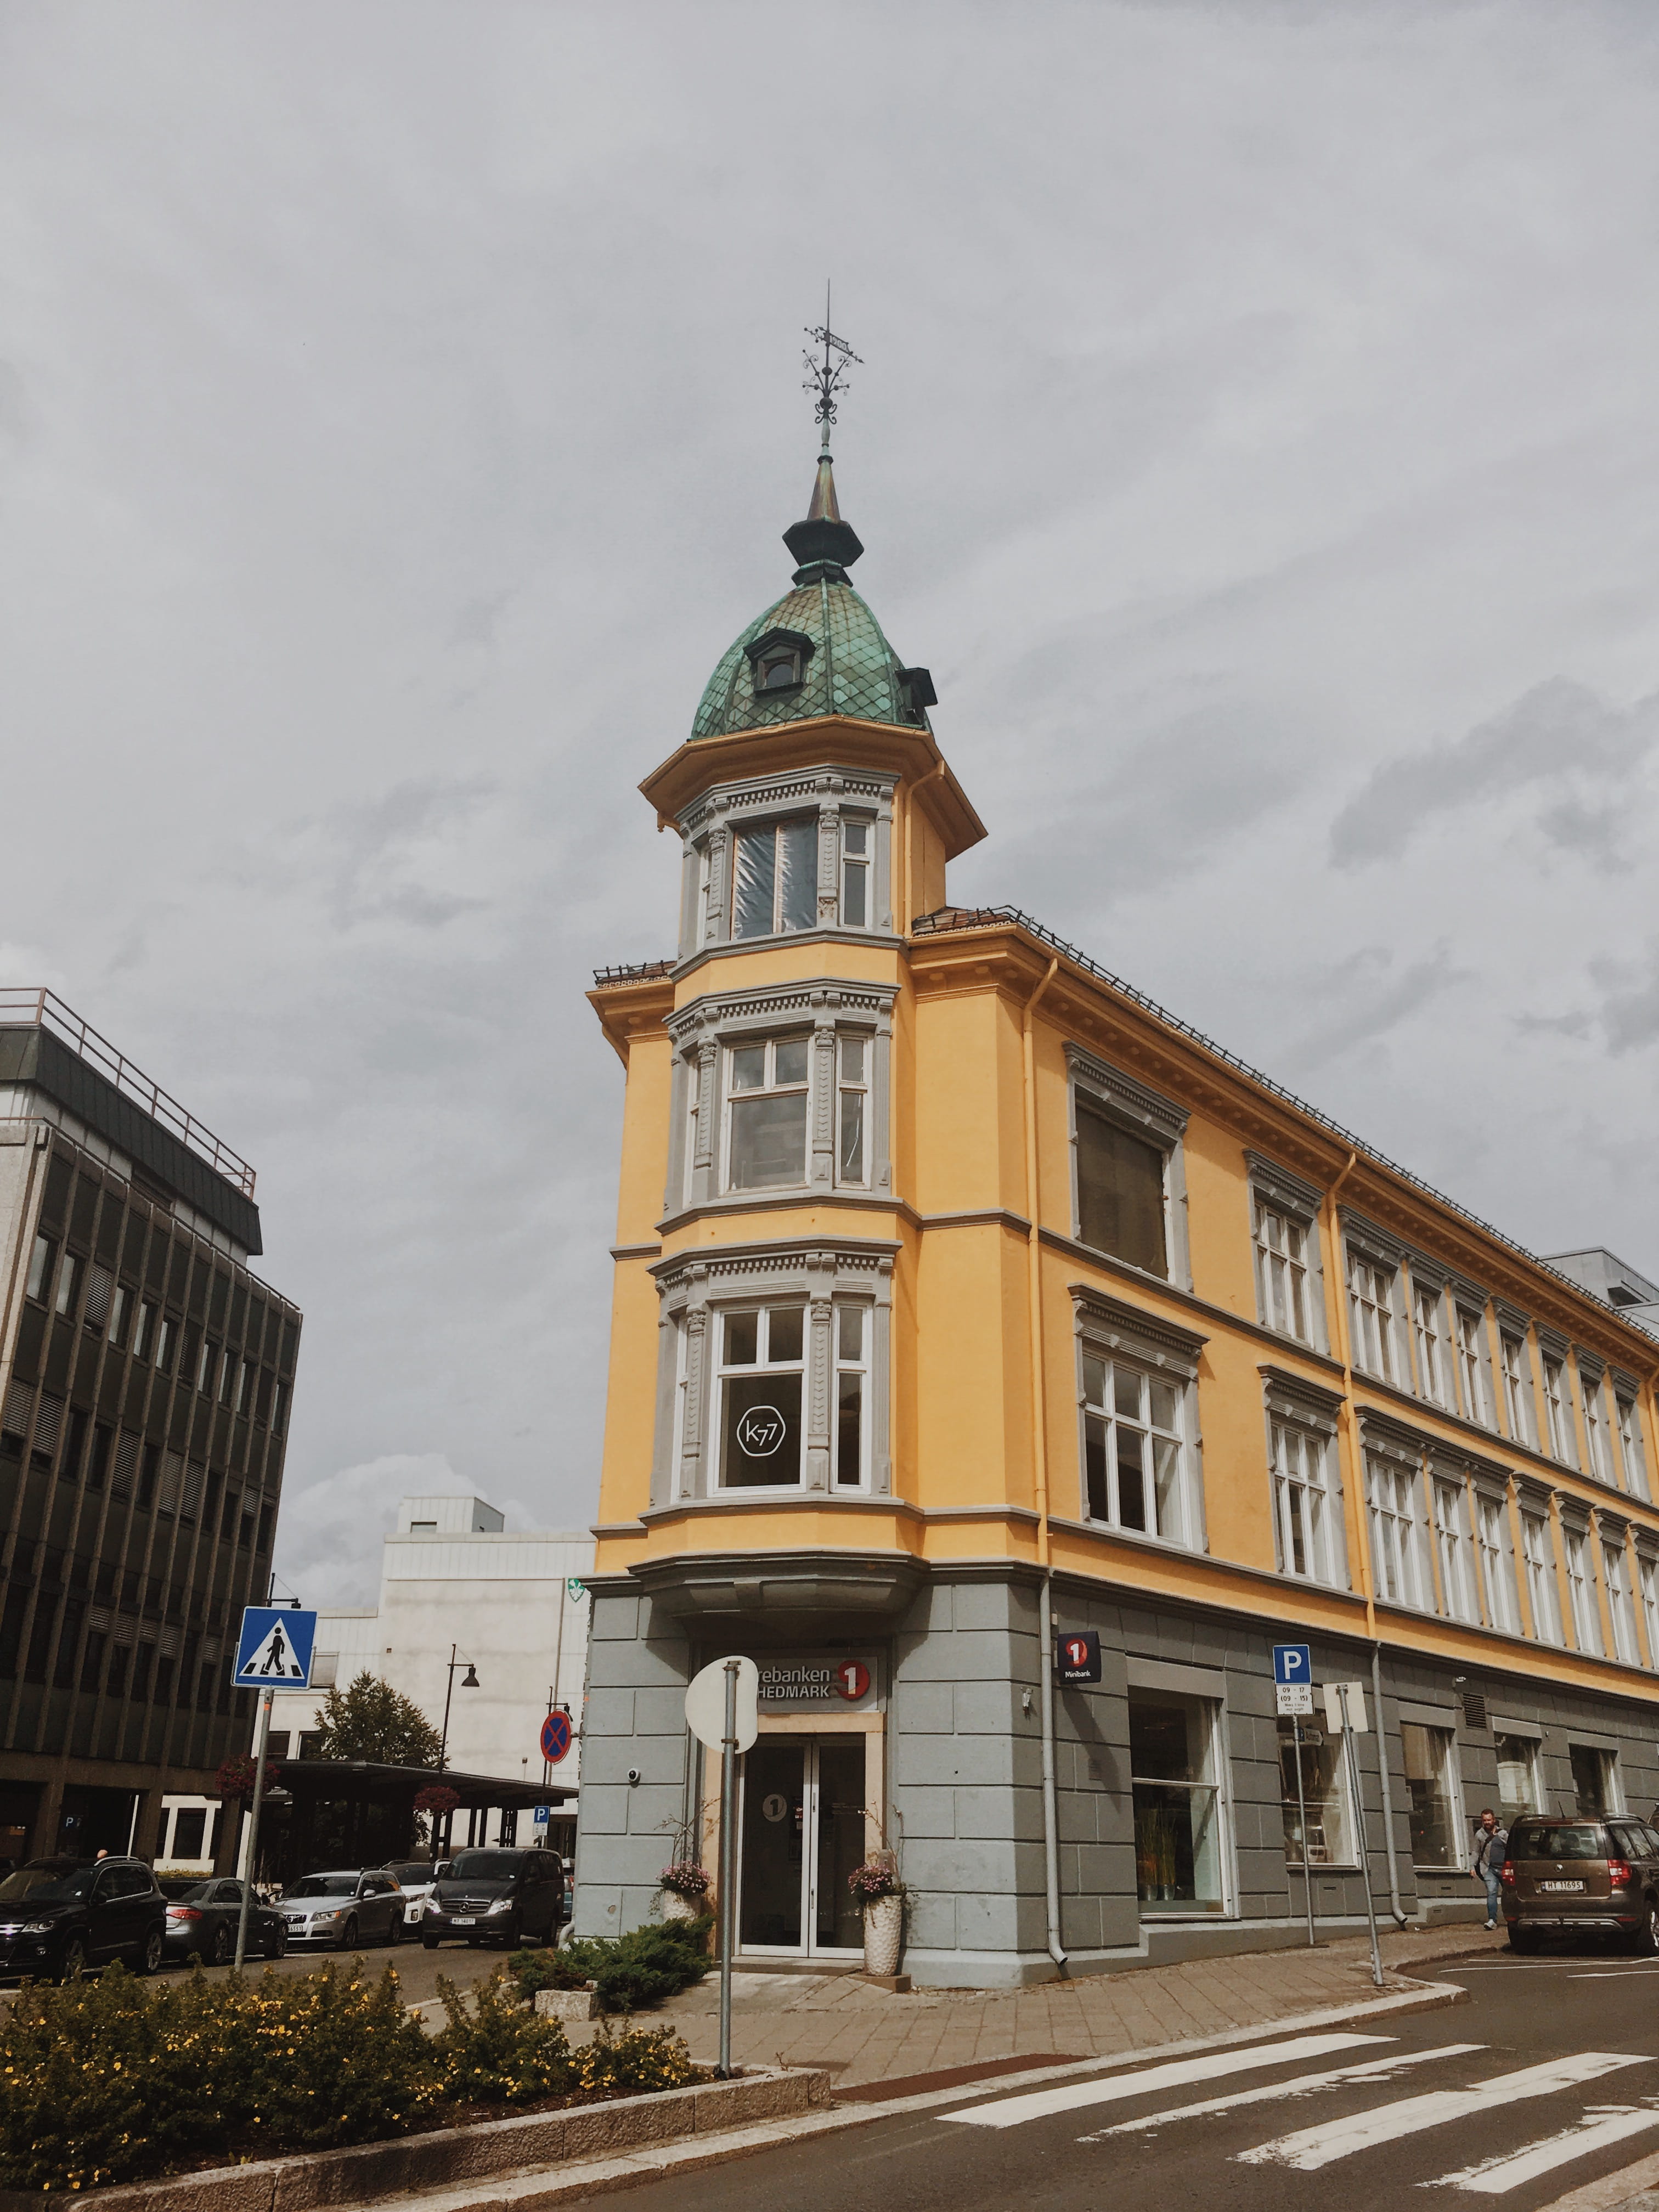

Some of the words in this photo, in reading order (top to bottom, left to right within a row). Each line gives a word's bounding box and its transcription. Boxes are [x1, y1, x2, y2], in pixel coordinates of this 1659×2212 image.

[1070, 1643, 1080, 1664] 1
[1283, 1651, 1302, 1680] P
[758, 1666, 830, 1683] rebanken
[844, 1667, 856, 1695] 1
[758, 1685, 830, 1699] HEDMARK
[66, 1817, 74, 1827] P
[537, 1808, 545, 1821] P
